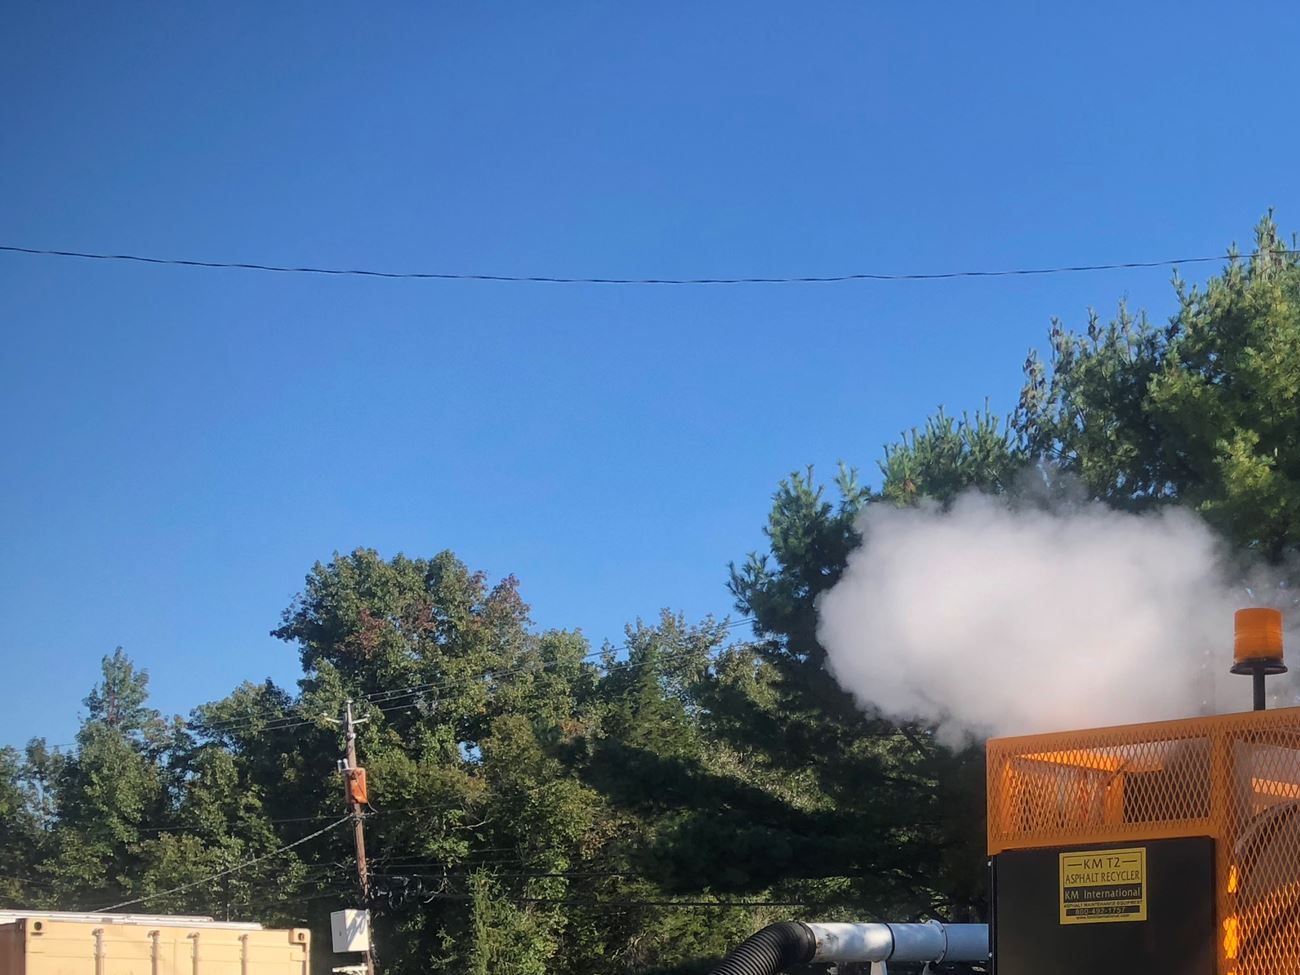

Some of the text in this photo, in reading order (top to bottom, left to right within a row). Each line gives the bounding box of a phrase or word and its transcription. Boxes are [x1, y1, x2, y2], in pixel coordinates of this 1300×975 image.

[1083, 857, 1121, 870] KM T2
[1065, 870, 1140, 884] ASPHALT RECYCLER
[1064, 887, 1140, 900] KM International
